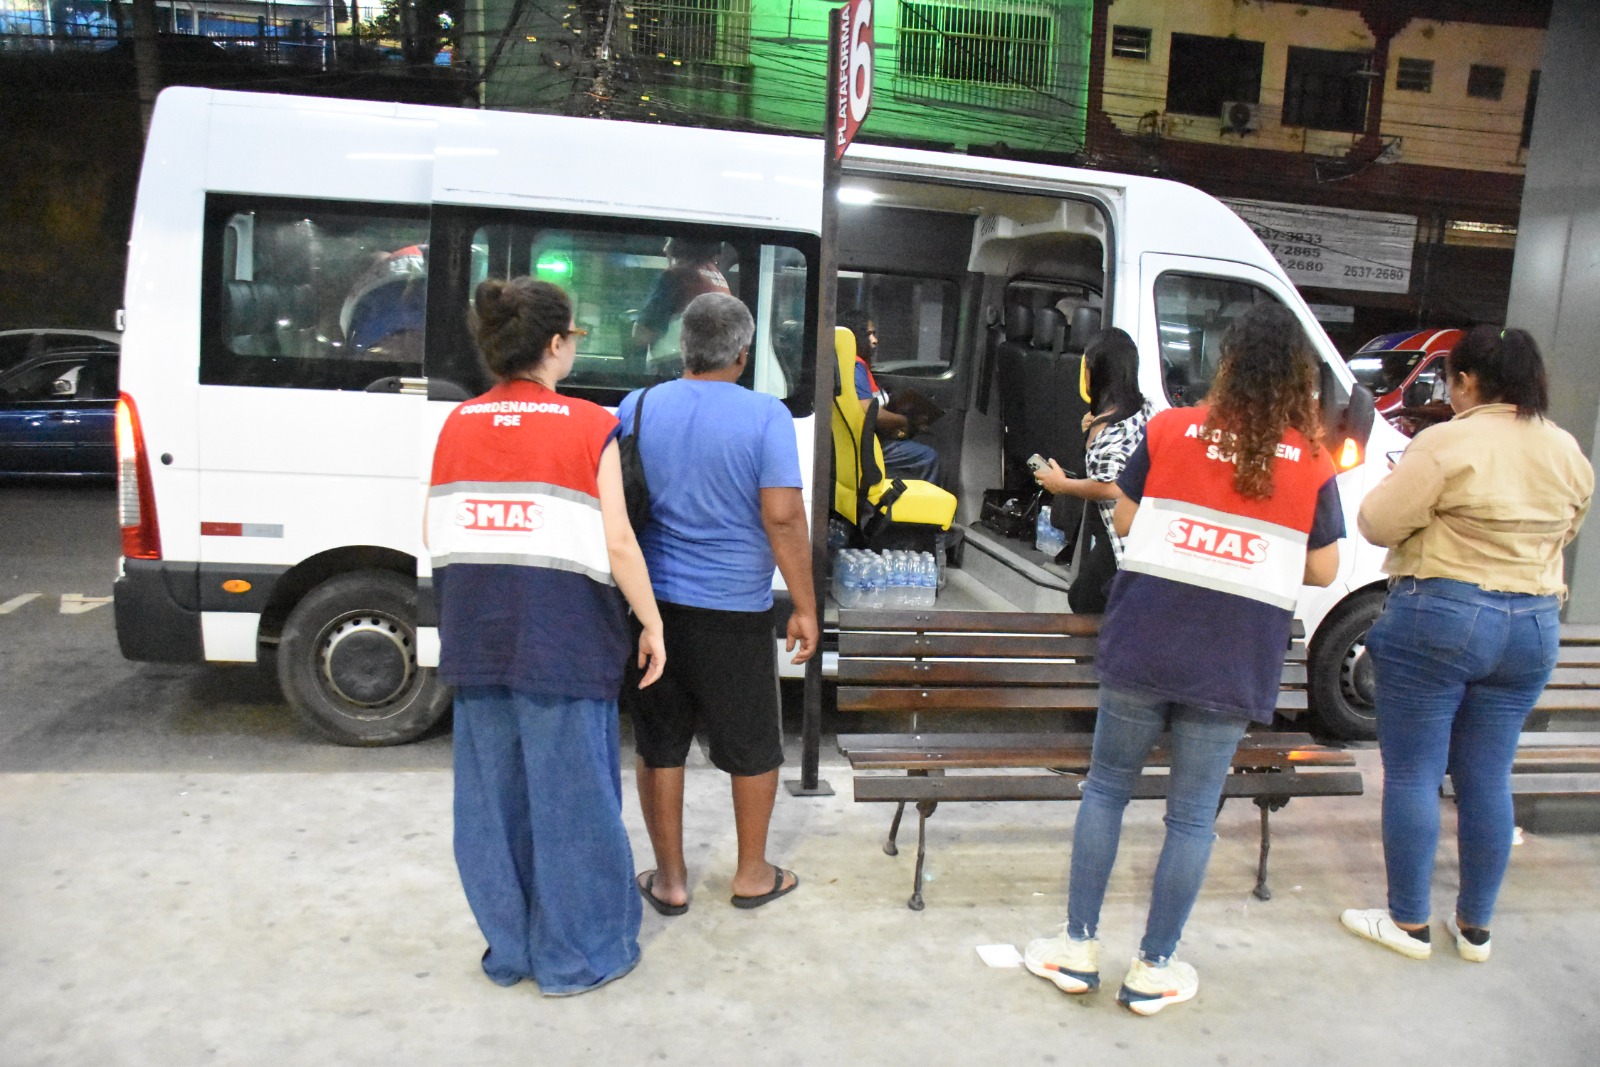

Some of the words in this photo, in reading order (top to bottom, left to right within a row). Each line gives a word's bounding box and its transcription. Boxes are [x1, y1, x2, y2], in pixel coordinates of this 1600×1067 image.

[837, 5, 851, 146] PLATAFORMA
[849, 0, 872, 122] 6
[1343, 265, 1404, 280] 2637-2680
[460, 401, 570, 416] COORDENADORA
[493, 414, 521, 427] PSE
[455, 501, 545, 531] SMAS
[1165, 519, 1270, 563] SMAS
